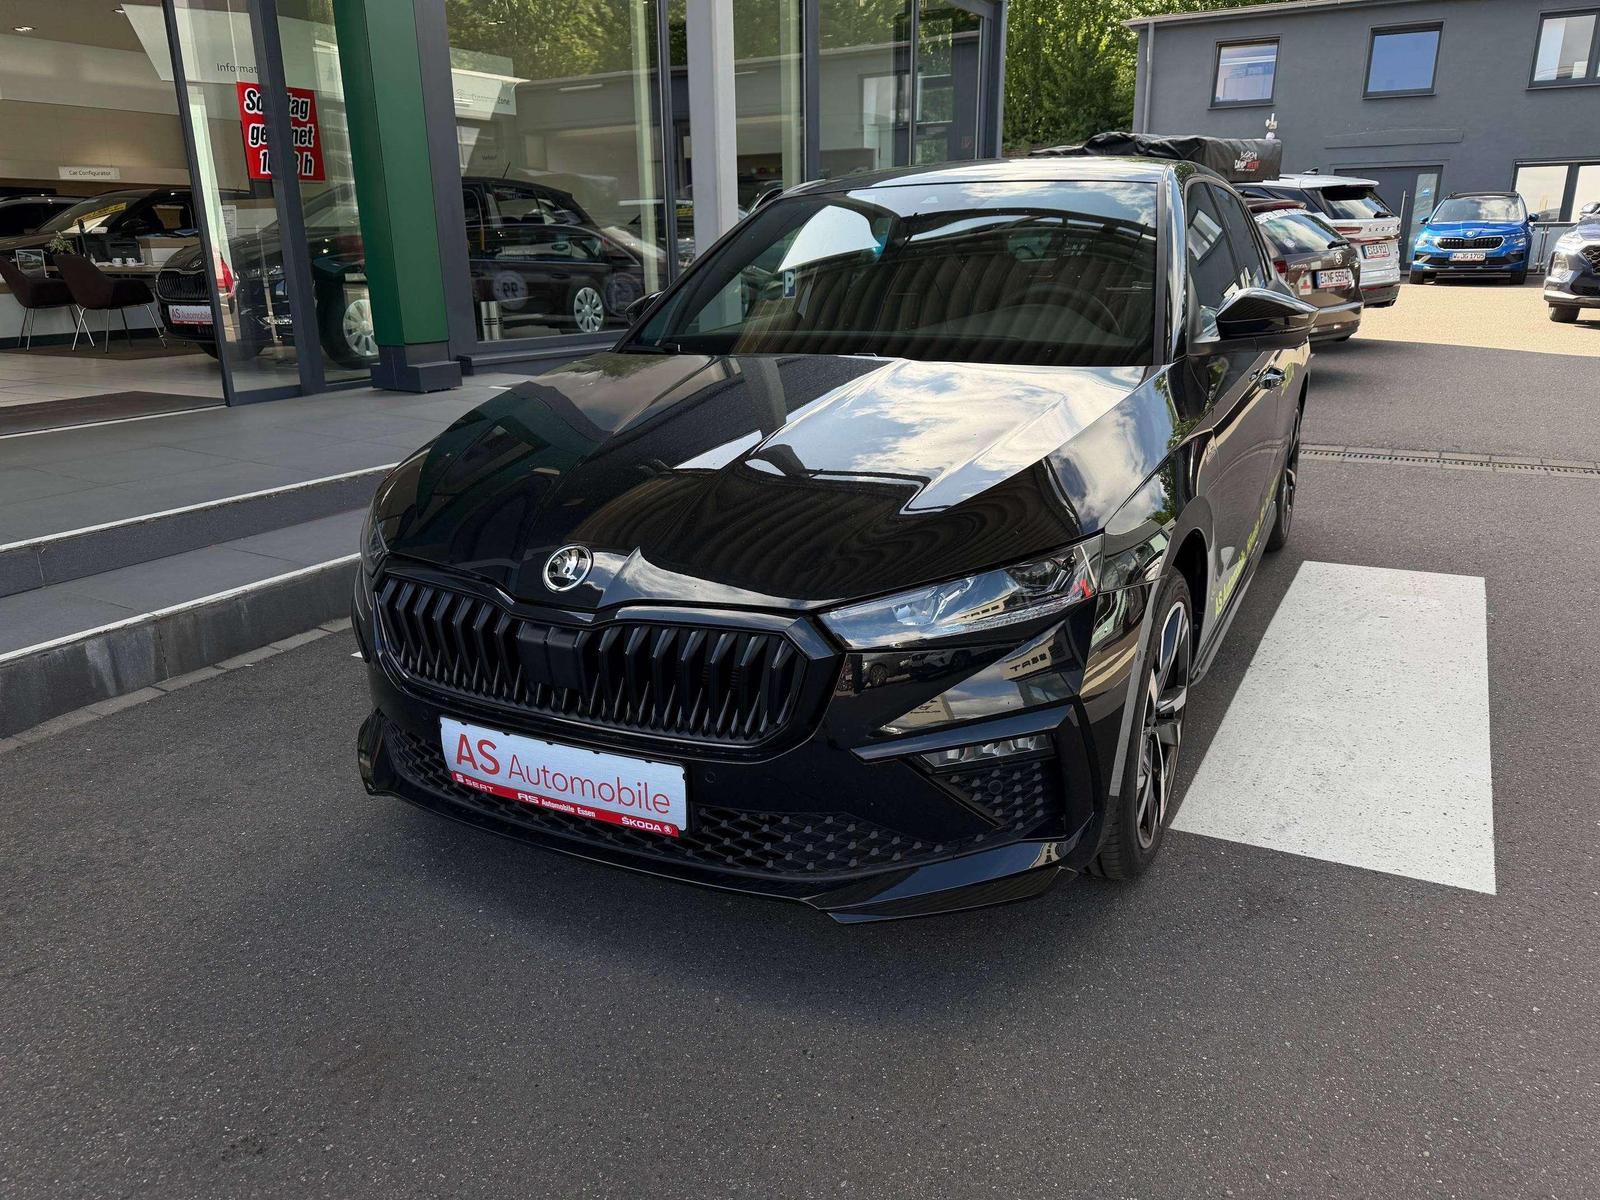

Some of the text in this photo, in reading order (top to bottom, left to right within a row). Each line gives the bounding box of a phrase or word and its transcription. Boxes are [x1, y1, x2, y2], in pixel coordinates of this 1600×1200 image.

[456, 733, 671, 814] AS Automobile
[465, 778, 494, 793] SEAT
[541, 798, 575, 813] Automobile
[577, 807, 596, 818] Essen
[621, 816, 662, 832] ŠKODA
